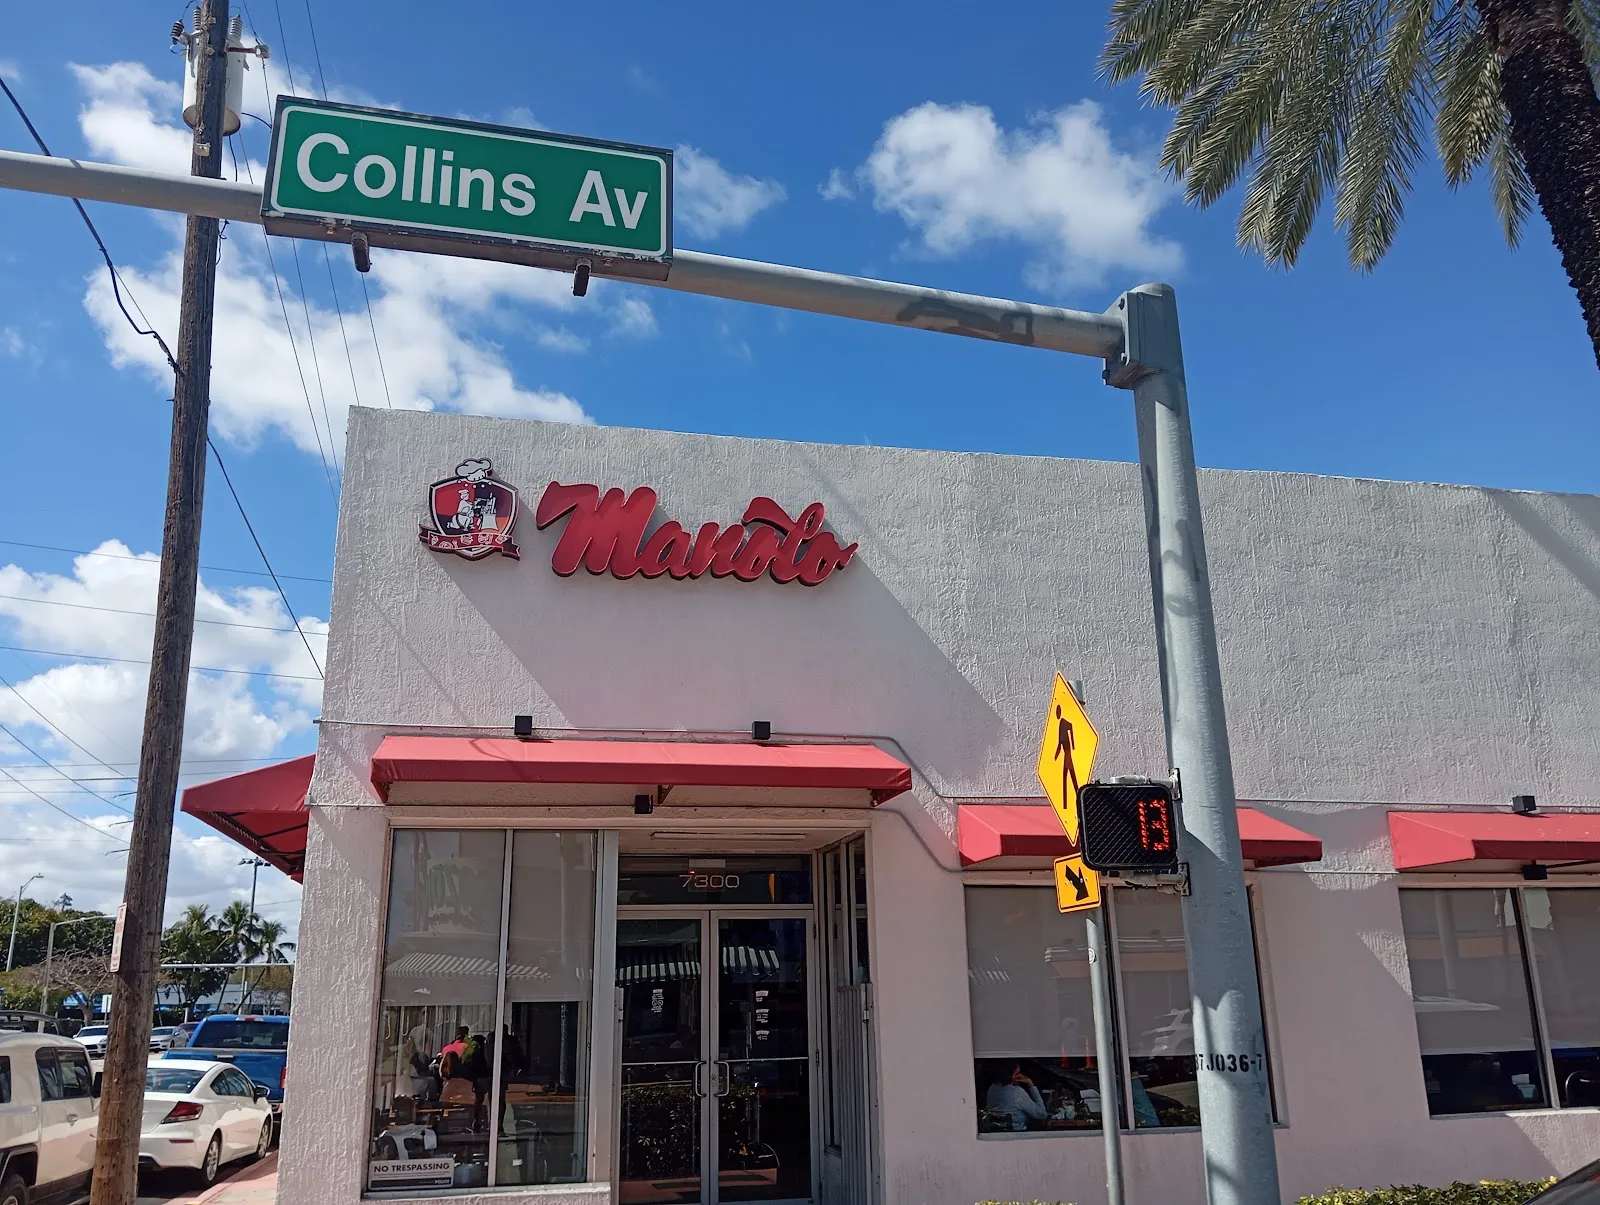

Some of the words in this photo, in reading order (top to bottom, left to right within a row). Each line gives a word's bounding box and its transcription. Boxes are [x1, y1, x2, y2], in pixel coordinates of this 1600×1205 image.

[296, 132, 536, 216] Collins
[568, 169, 649, 230] Av
[535, 481, 859, 585] Manolo
[1138, 799, 1170, 851] 13
[679, 874, 740, 888] 7300
[392, 1162, 450, 1172] TRESPASSING
